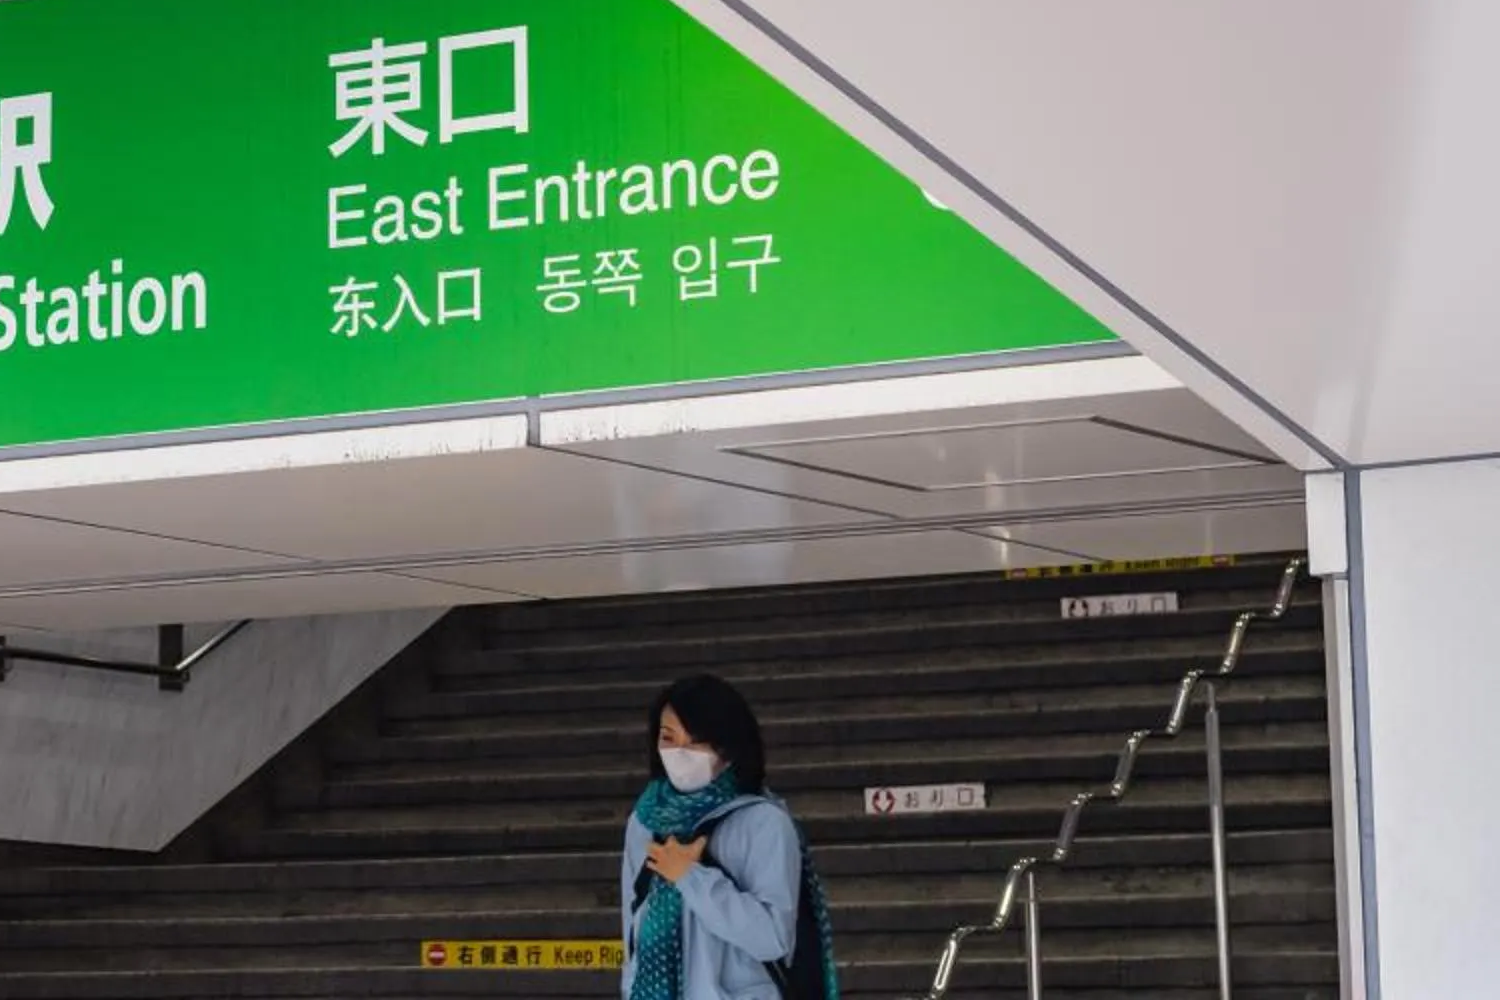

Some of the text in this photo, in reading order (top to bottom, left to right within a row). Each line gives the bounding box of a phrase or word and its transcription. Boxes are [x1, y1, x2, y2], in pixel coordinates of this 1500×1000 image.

[328, 24, 529, 158] 東口
[327, 148, 780, 249] East Entrance
[328, 266, 482, 337] 东入口
[535, 233, 781, 313] 동쪽 입구
[904, 787, 975, 808] おり口
[458, 945, 623, 967] 右側通行 Keep Rig
